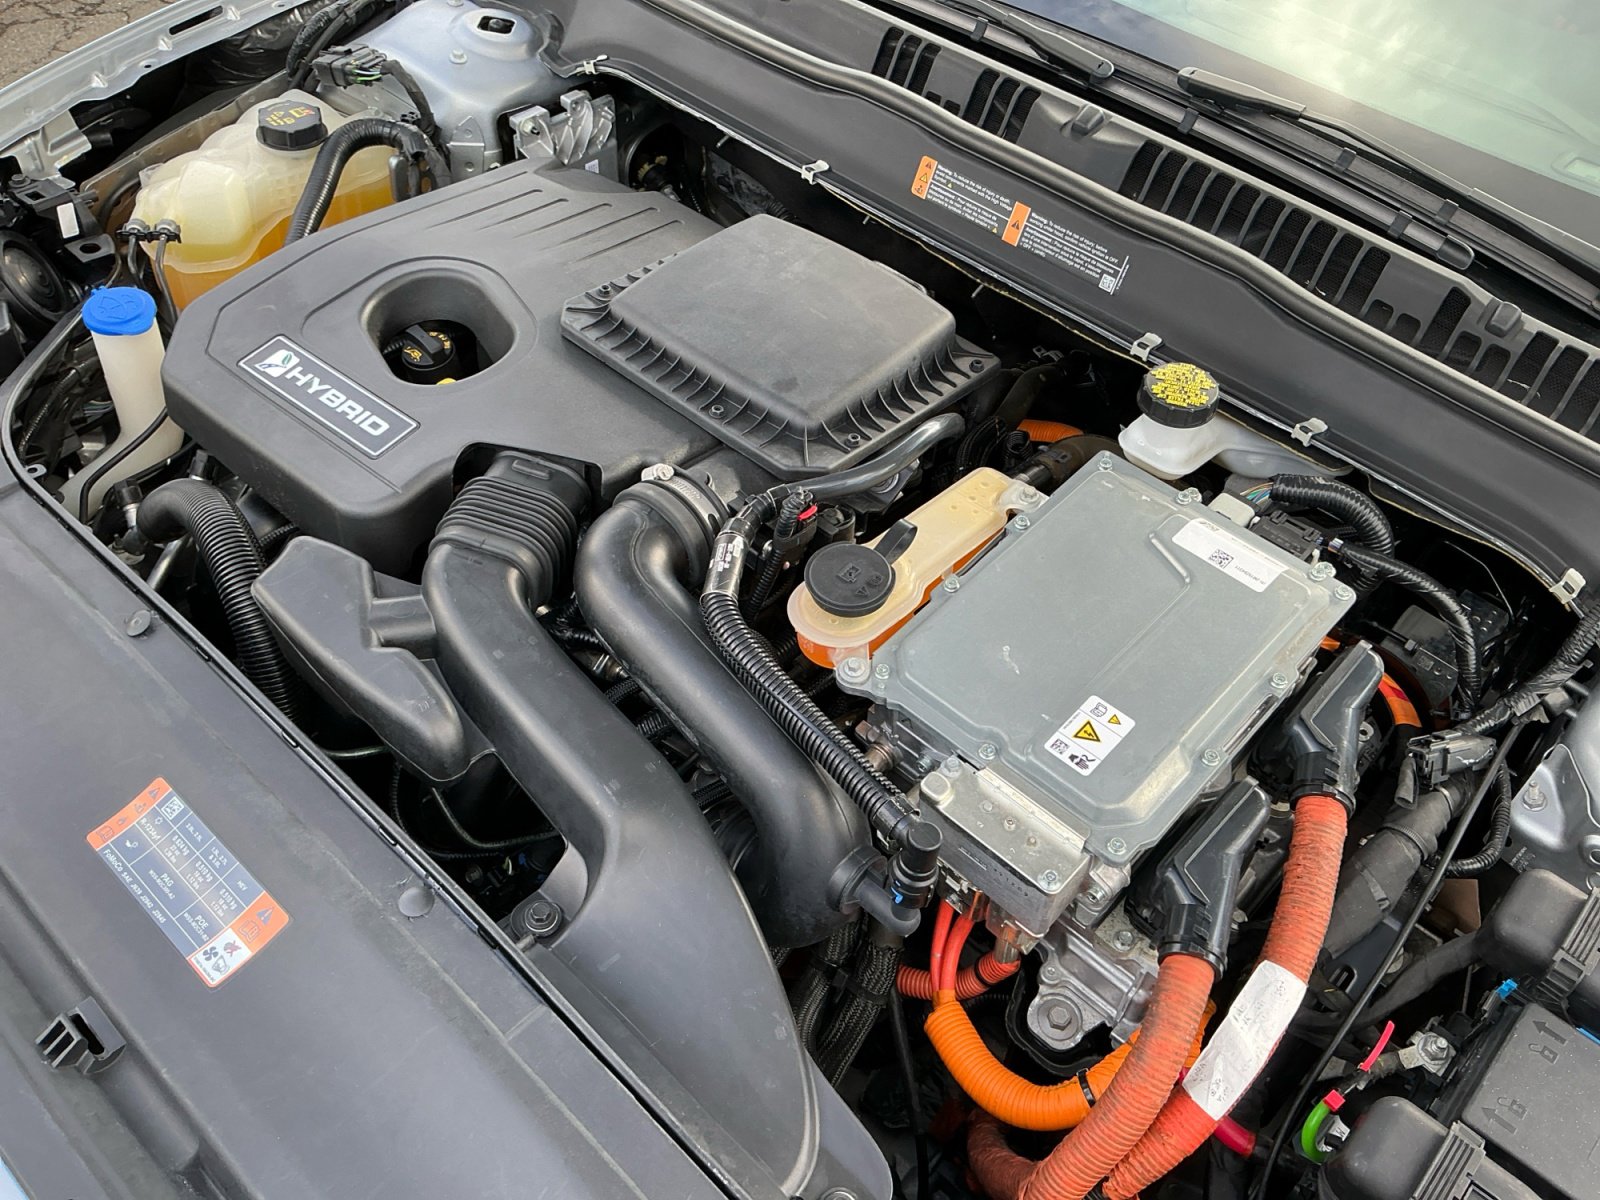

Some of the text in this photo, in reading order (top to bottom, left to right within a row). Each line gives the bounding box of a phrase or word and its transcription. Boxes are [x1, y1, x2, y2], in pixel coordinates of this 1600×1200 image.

[936, 164, 952, 175] Warning:
[990, 197, 999, 205] High
[998, 201, 1012, 212] Voltage
[1030, 212, 1048, 224] Warning:
[1095, 243, 1108, 253] before
[285, 366, 390, 435] HYBRID
[137, 816, 162, 842] R-1234yf
[179, 845, 191, 856] kg
[102, 847, 125, 873] FoMoCo
[120, 870, 133, 883] SAE
[159, 872, 174, 887] PAG
[203, 871, 215, 883] kg
[227, 899, 239, 910] kg
[194, 914, 209, 930] POE
